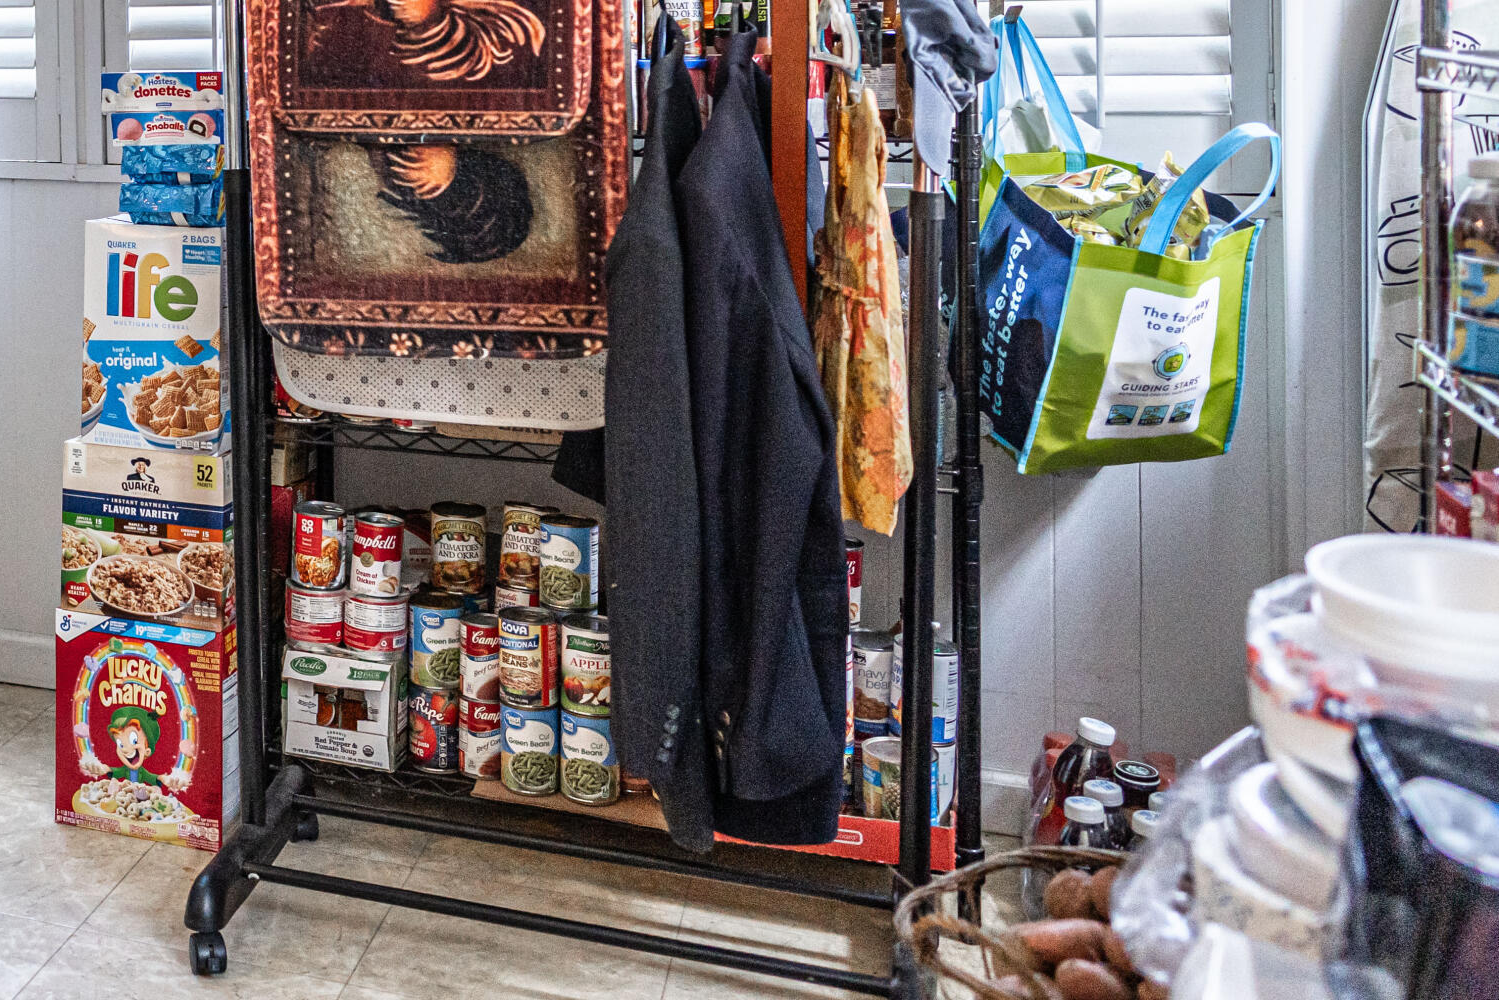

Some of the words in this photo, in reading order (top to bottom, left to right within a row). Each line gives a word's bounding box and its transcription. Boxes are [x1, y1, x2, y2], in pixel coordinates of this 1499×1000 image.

[665, 2, 701, 10] OMATES
[148, 79, 177, 87] Hostess
[134, 86, 192, 98] donettes
[146, 121, 184, 132] Snoballs
[107, 240, 137, 249] QUAKER
[182, 235, 188, 243] 2
[190, 235, 216, 244] BAGS
[1006, 227, 1032, 279] way
[106, 251, 199, 322] life
[998, 264, 1029, 344] better
[1143, 305, 1168, 320] The
[982, 283, 1009, 355] faster
[113, 320, 159, 329] MULTIGRAIN
[162, 323, 189, 331] CEREAL
[1147, 320, 1161, 331] to
[1166, 325, 1185, 334] eat
[105, 352, 157, 370] original
[996, 346, 1007, 386] eat
[979, 359, 992, 400] The
[1121, 382, 1170, 393] GUIDING
[1174, 377, 1199, 391] STARS
[992, 391, 1002, 416] to
[196, 464, 213, 483] 52
[121, 481, 160, 495] QUAKER
[111, 498, 138, 506] INSTANT
[139, 501, 170, 510] OATMEAL
[102, 504, 136, 516] FLAVOR
[139, 507, 180, 521] VARIETY
[505, 534, 540, 544] TOMATOE
[438, 542, 479, 552] TOMATOES
[554, 556, 575, 564] Beans
[356, 569, 371, 578] Cream
[357, 576, 376, 586] Chicken
[68, 589, 88, 597] HEALTHY
[502, 621, 528, 634] GOYA
[502, 651, 529, 661] REFRIED
[295, 658, 324, 671] Pacific
[502, 658, 528, 668] BEANS
[570, 657, 611, 670] APPLE
[108, 657, 162, 691] Lucky
[353, 670, 362, 679] 12
[473, 665, 487, 678] Beef
[858, 668, 887, 680] navy
[99, 680, 168, 715] Charms
[415, 696, 444, 721] Ripe
[314, 736, 327, 744] Red
[329, 737, 350, 748] Pepper
[508, 737, 528, 746] Green
[315, 743, 339, 752] Tomato
[340, 747, 357, 756] Soup
[476, 742, 490, 754] Beef
[581, 748, 603, 756] Beans
